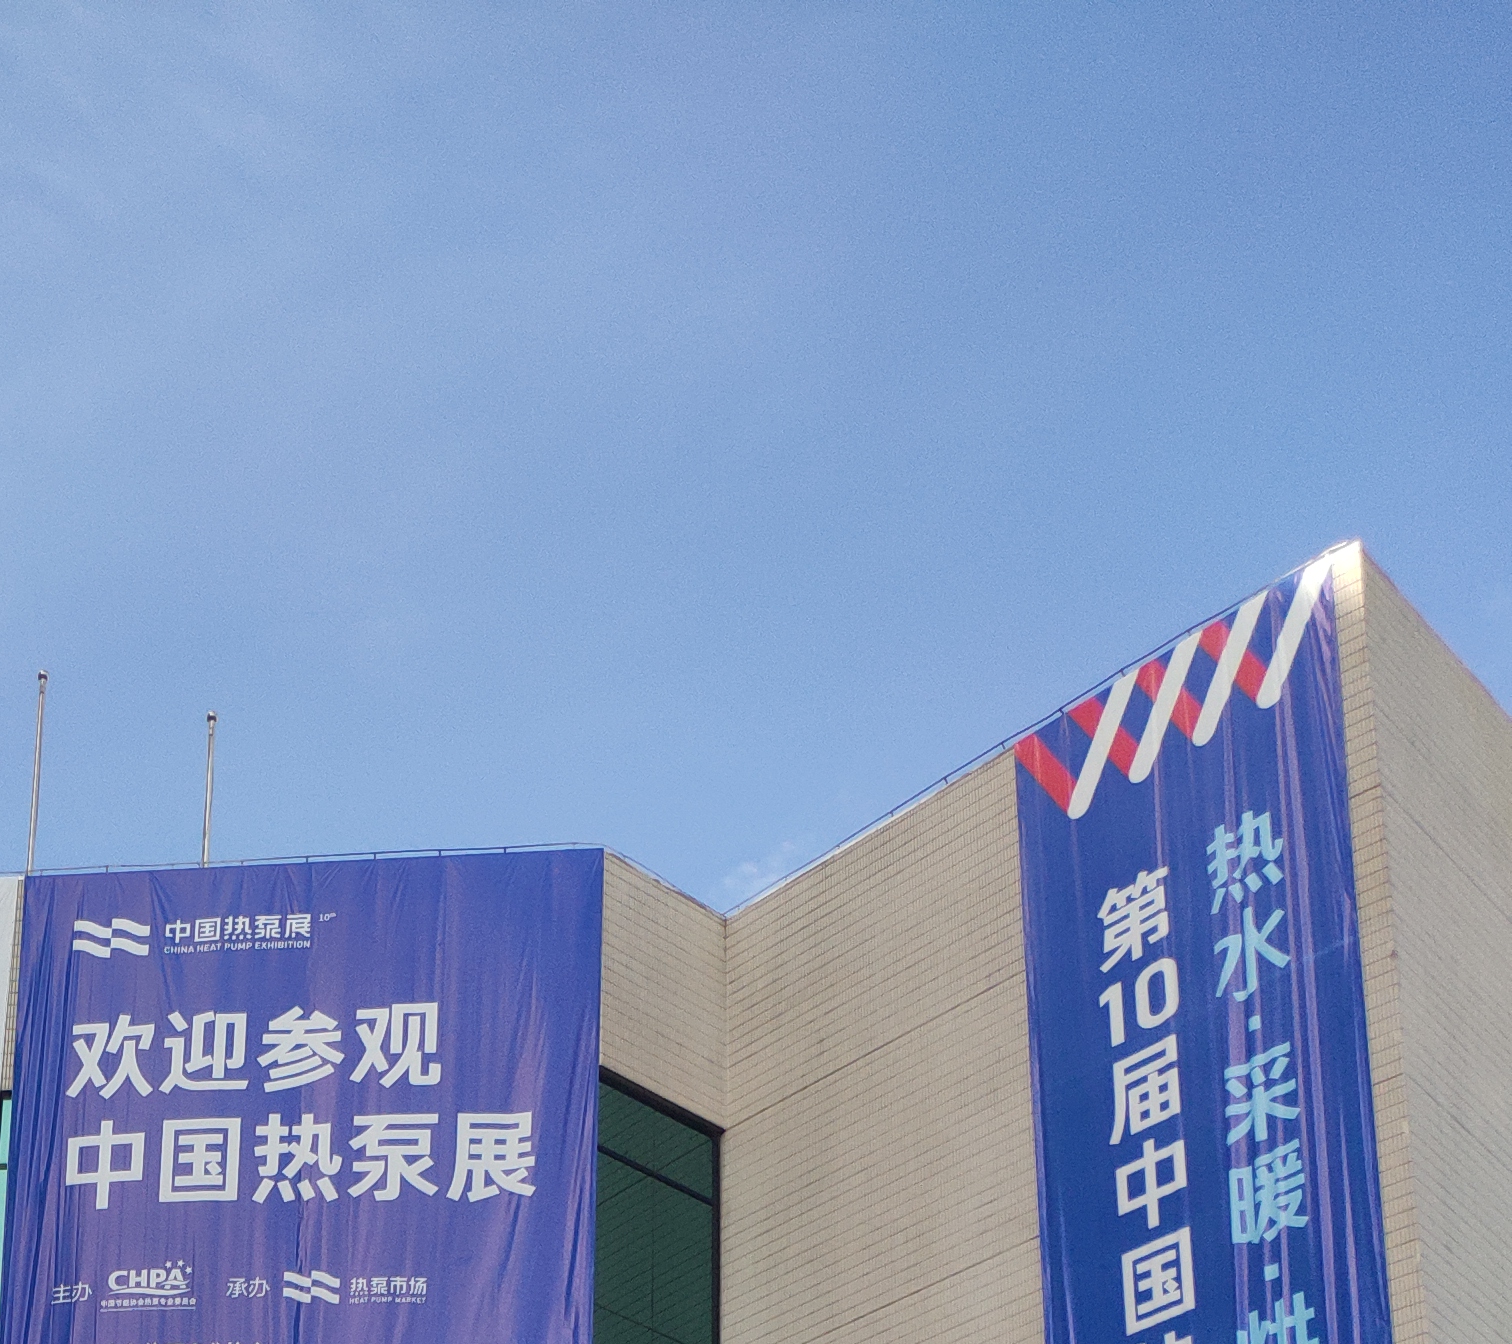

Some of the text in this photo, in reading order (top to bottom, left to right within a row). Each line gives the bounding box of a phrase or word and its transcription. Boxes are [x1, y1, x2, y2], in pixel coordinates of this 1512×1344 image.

[165, 913, 312, 943] 中国热泵展
[164, 940, 311, 954] CHINA HEAT PUMP EXHIBITION
[65, 1002, 441, 1100] 欢迎参观
[64, 1111, 537, 1210] 中国热泵展
[51, 1268, 428, 1305] 主办 CHPA 承办 热泵市场
